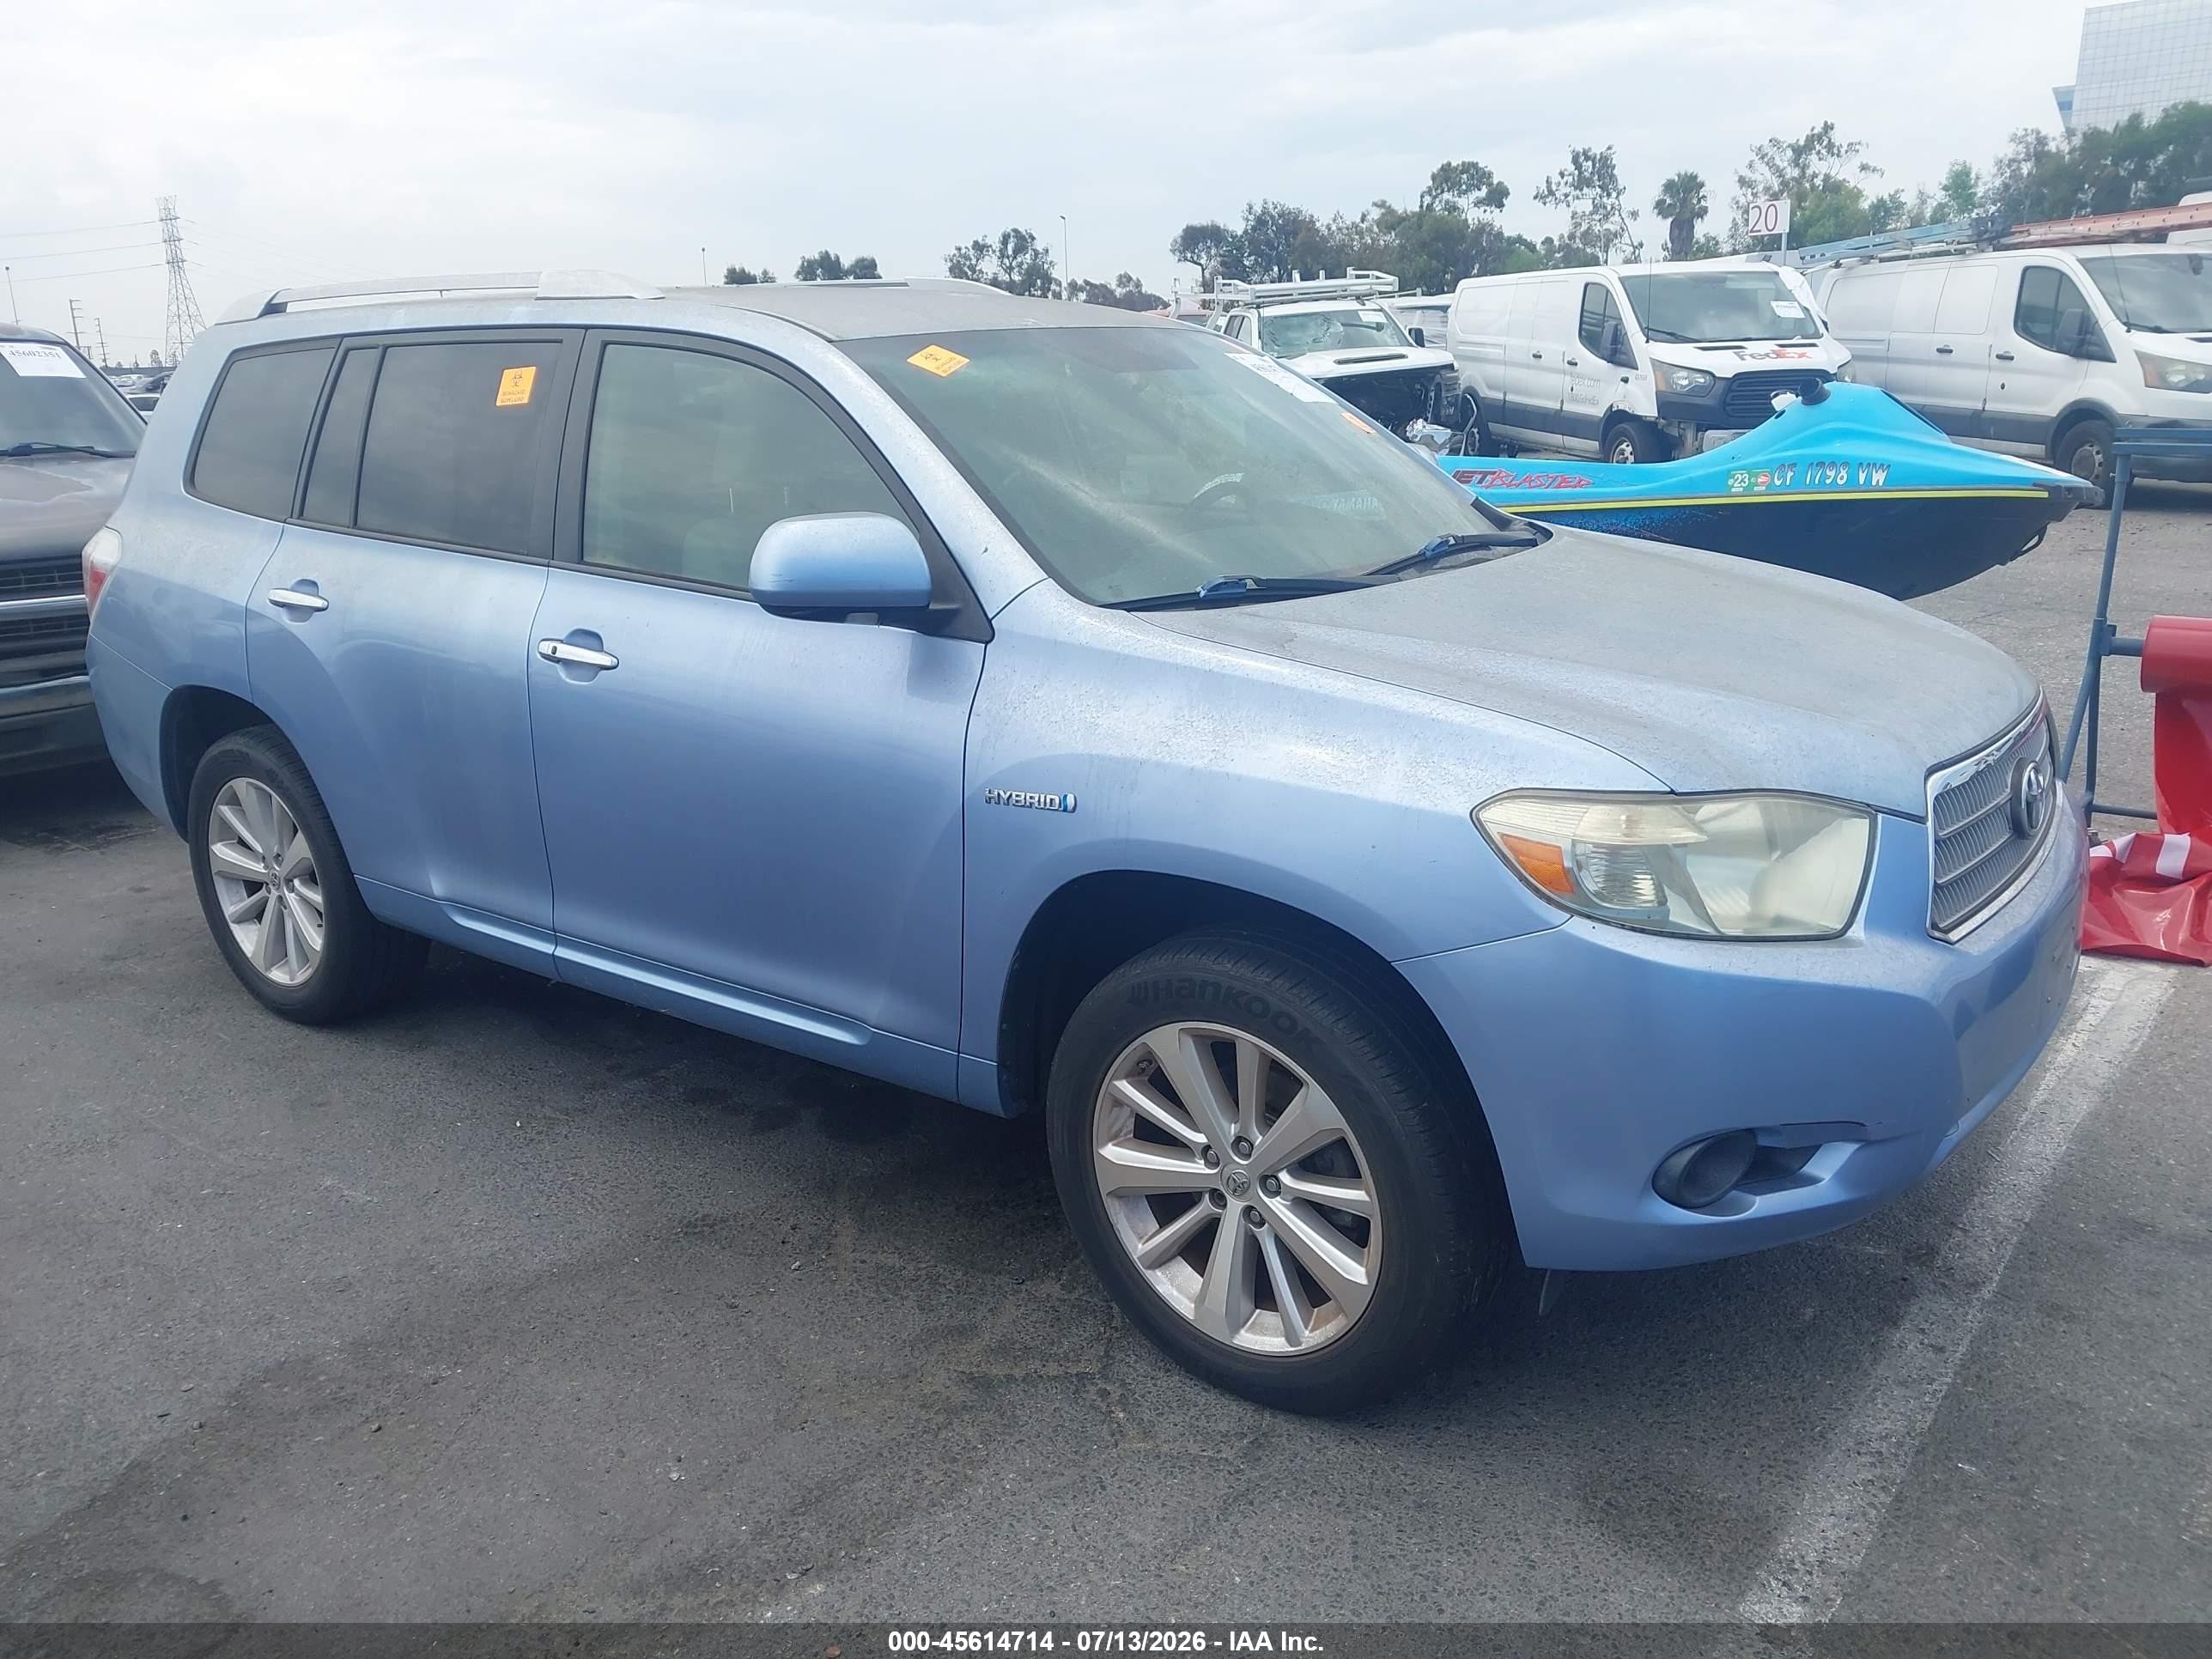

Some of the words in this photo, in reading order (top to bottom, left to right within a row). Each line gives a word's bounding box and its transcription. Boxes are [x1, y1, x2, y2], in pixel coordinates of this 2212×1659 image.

[1749, 203, 1778, 234] 20
[1732, 349, 1814, 362] FedEx
[1734, 473, 1749, 487] 23
[1773, 463, 1797, 487] CF
[1805, 461, 1849, 486] 1798
[1856, 463, 1891, 487] VW
[984, 788, 1061, 811] HYBRID
